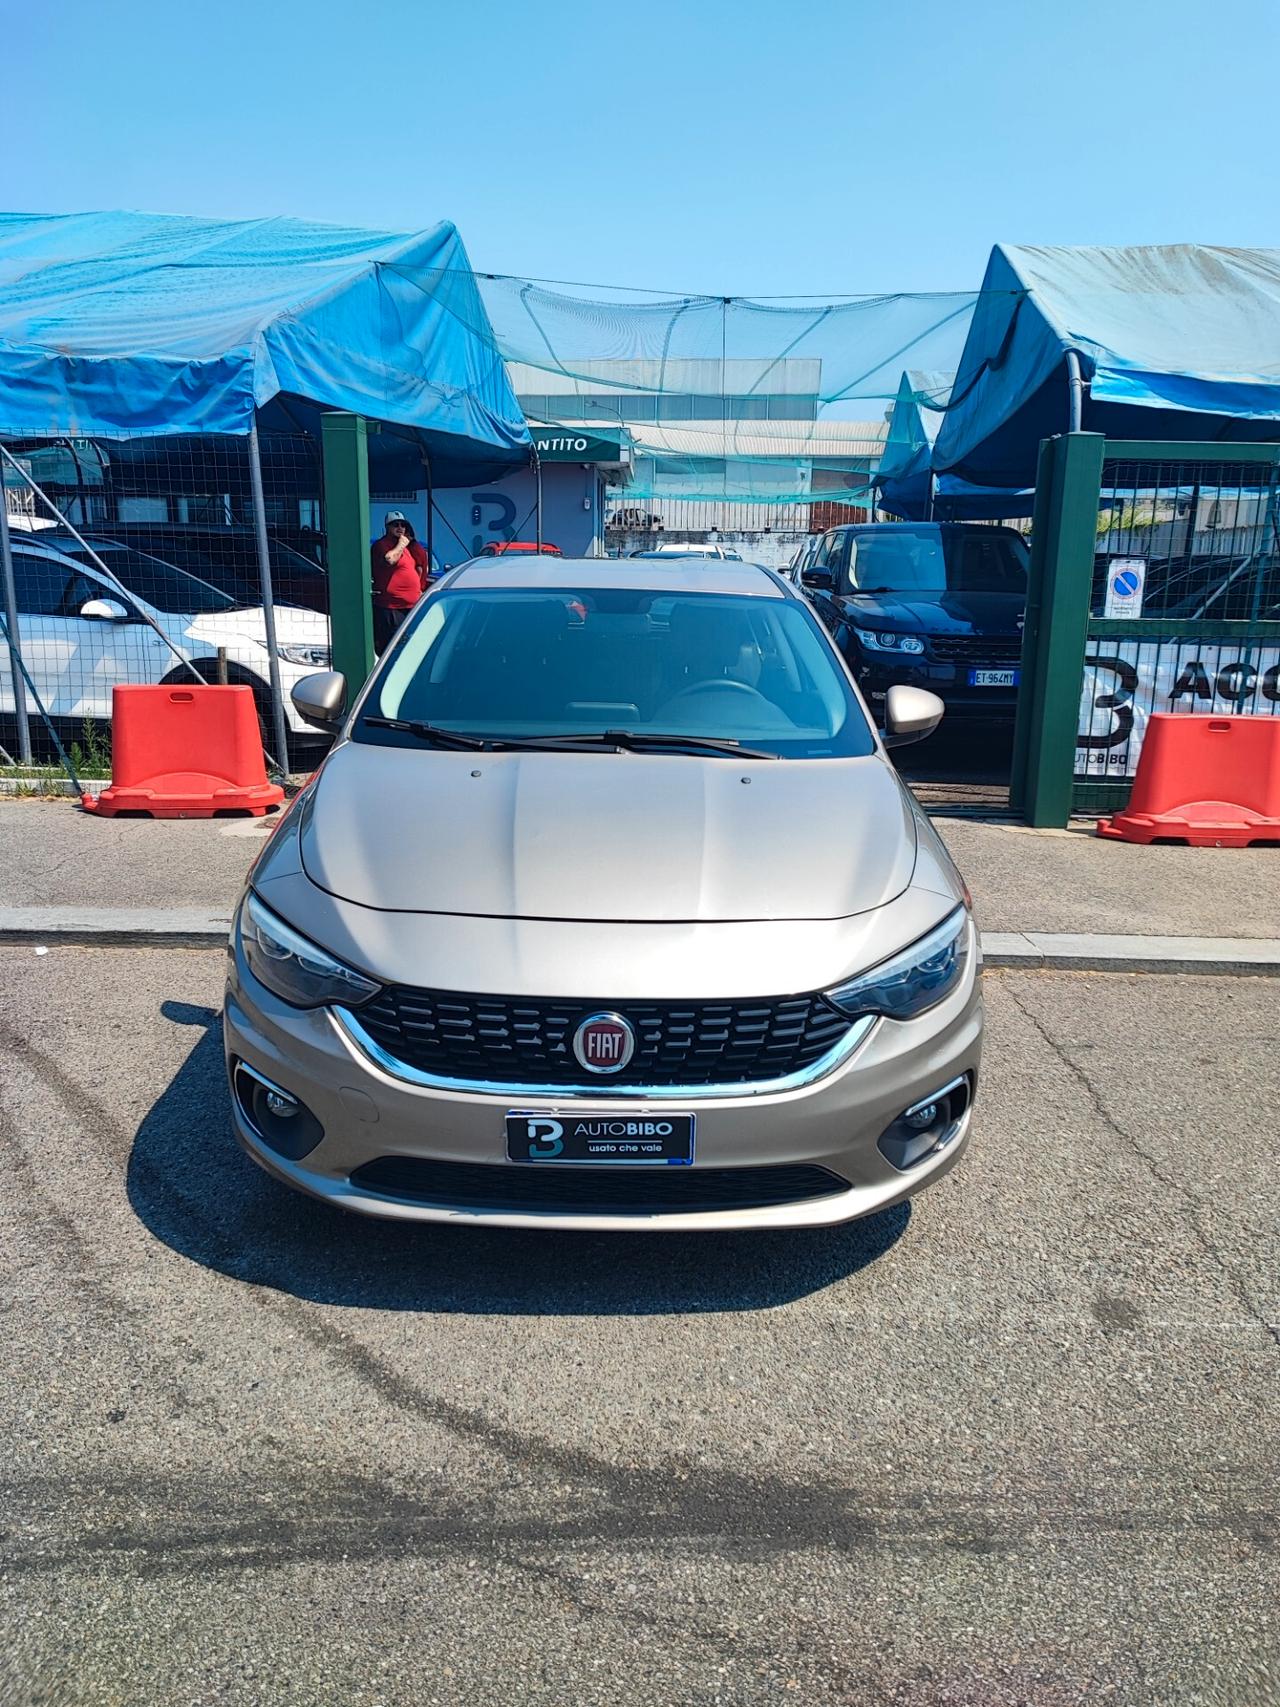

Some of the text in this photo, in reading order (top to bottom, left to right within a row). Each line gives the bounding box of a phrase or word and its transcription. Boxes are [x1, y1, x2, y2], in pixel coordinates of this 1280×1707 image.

[587, 1032, 622, 1058] FIAT
[574, 1122, 673, 1135] AUTOBIBO
[588, 1144, 662, 1152] usato che vale
